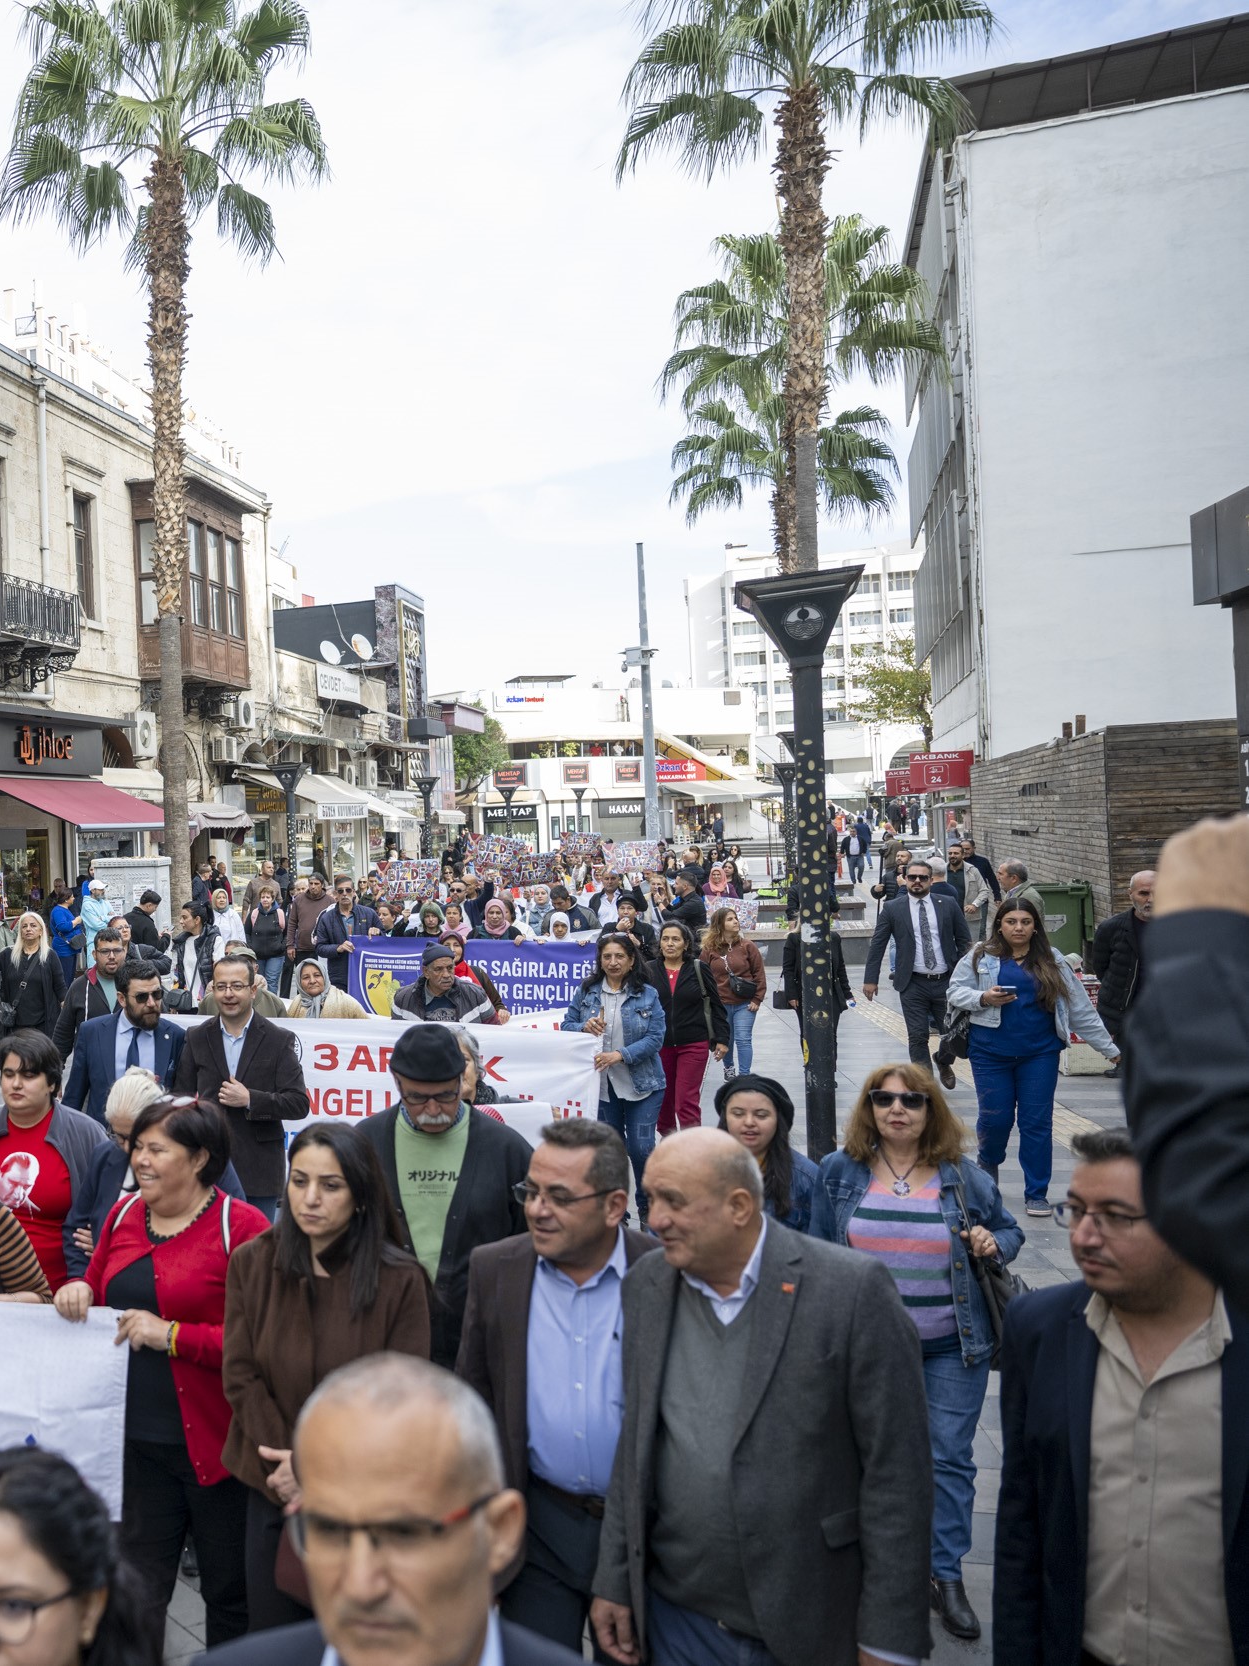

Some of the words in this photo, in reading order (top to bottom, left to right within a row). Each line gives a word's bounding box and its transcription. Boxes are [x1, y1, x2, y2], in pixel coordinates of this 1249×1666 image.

[914, 752, 960, 761] AKBANK
[497, 770, 521, 778] MEHTAP
[608, 804, 642, 815] HAKAN
[499, 843, 515, 855] DE
[635, 846, 649, 856] DE
[410, 867, 427, 880] DE
[491, 957, 569, 979] SAĞIRLAR
[573, 960, 598, 980] EĞİ
[313, 1043, 339, 1071] 3
[408, 1170, 459, 1182] オリジナル
